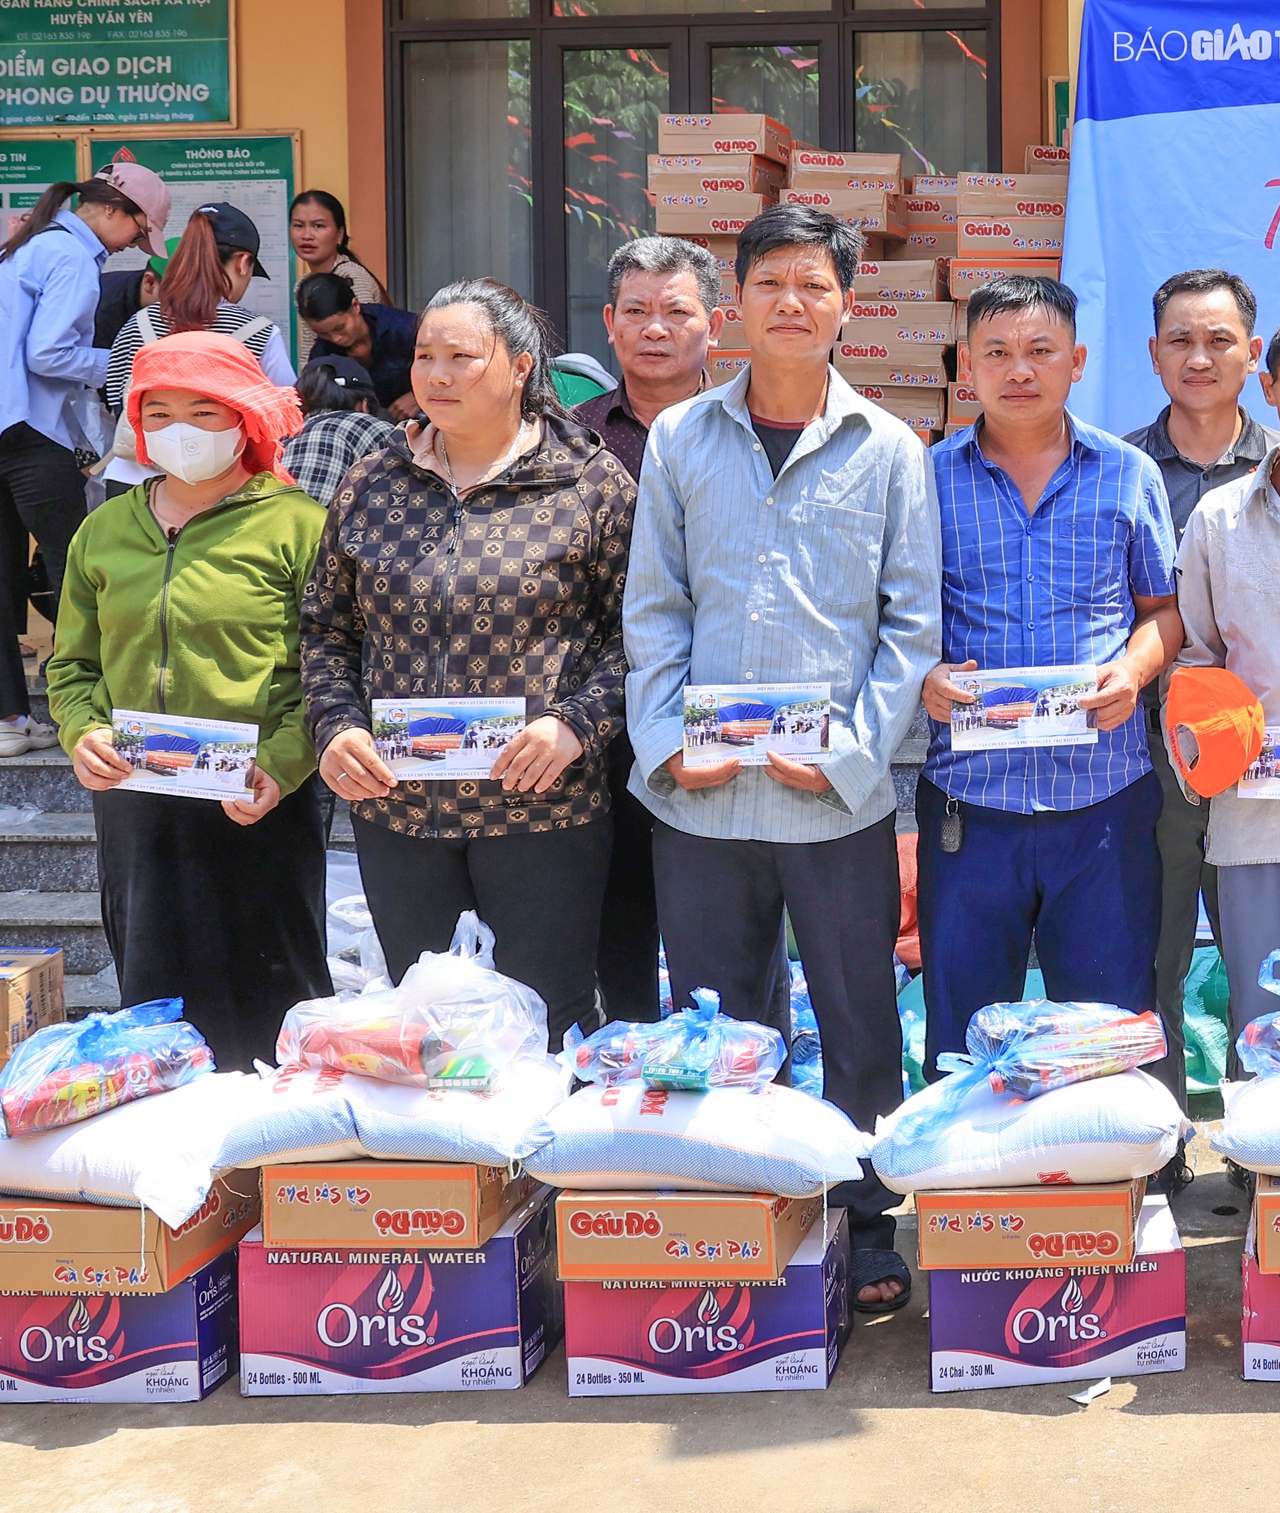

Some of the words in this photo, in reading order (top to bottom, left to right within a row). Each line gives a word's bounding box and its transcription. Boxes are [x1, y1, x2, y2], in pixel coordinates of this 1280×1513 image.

[50, 11, 93, 28] HUYỆN
[98, 11, 125, 24] VĂN
[129, 10, 153, 24] YÊN
[1113, 26, 1188, 62] BÁO
[52, 57, 110, 76] GIAO
[117, 56, 172, 79] DỊCH
[80, 86, 110, 109] DỤ
[117, 82, 210, 108] THƯỢNG
[10, 154, 26, 162] TIN
[184, 148, 224, 159] THÔNG
[226, 147, 250, 158] BÁO
[277, 1186, 311, 1204] Phở
[316, 1182, 342, 1205] Sợi
[346, 1186, 371, 1206] Gà
[374, 1210, 410, 1236] Đỏ
[410, 1210, 466, 1236] Gấu
[569, 1211, 624, 1237] Gấu
[624, 1210, 662, 1236] Đỏ
[928, 1214, 963, 1232] Phở
[967, 1210, 995, 1233] Sợi
[1000, 1214, 1024, 1232] Gà
[665, 1240, 690, 1258] Gà
[694, 1240, 722, 1262] Sợi
[726, 1238, 762, 1260] Phở
[1028, 1233, 1065, 1258] Đỏ
[1066, 1232, 1119, 1256] Gấu
[267, 1252, 344, 1264] NATURAL
[348, 1252, 424, 1264] MINERAL
[428, 1252, 487, 1264] WATER
[54, 1266, 78, 1284] Gà
[84, 1265, 110, 1285] Sợi
[961, 1270, 1000, 1284] NƯỚC
[1005, 1266, 1064, 1281] KHOÁNG
[1115, 1262, 1158, 1274] NHIÊN
[317, 1302, 426, 1348] Oris
[648, 1317, 738, 1354] Oris
[1012, 1308, 1100, 1344] Oris
[20, 1326, 108, 1363] Oris
[1136, 1348, 1178, 1360] KHOÁNG
[248, 1372, 258, 1384] 24
[260, 1372, 286, 1384] Bottles
[292, 1372, 308, 1384] 500
[310, 1372, 322, 1384] ML
[461, 1365, 513, 1378] KHOÁNG
[776, 1362, 818, 1375] KHOÁNG
[939, 1367, 948, 1378] 24
[950, 1366, 964, 1378] Chai
[970, 1366, 982, 1377] 350
[984, 1366, 995, 1376] ML
[146, 1374, 190, 1387] KHOÁNG
